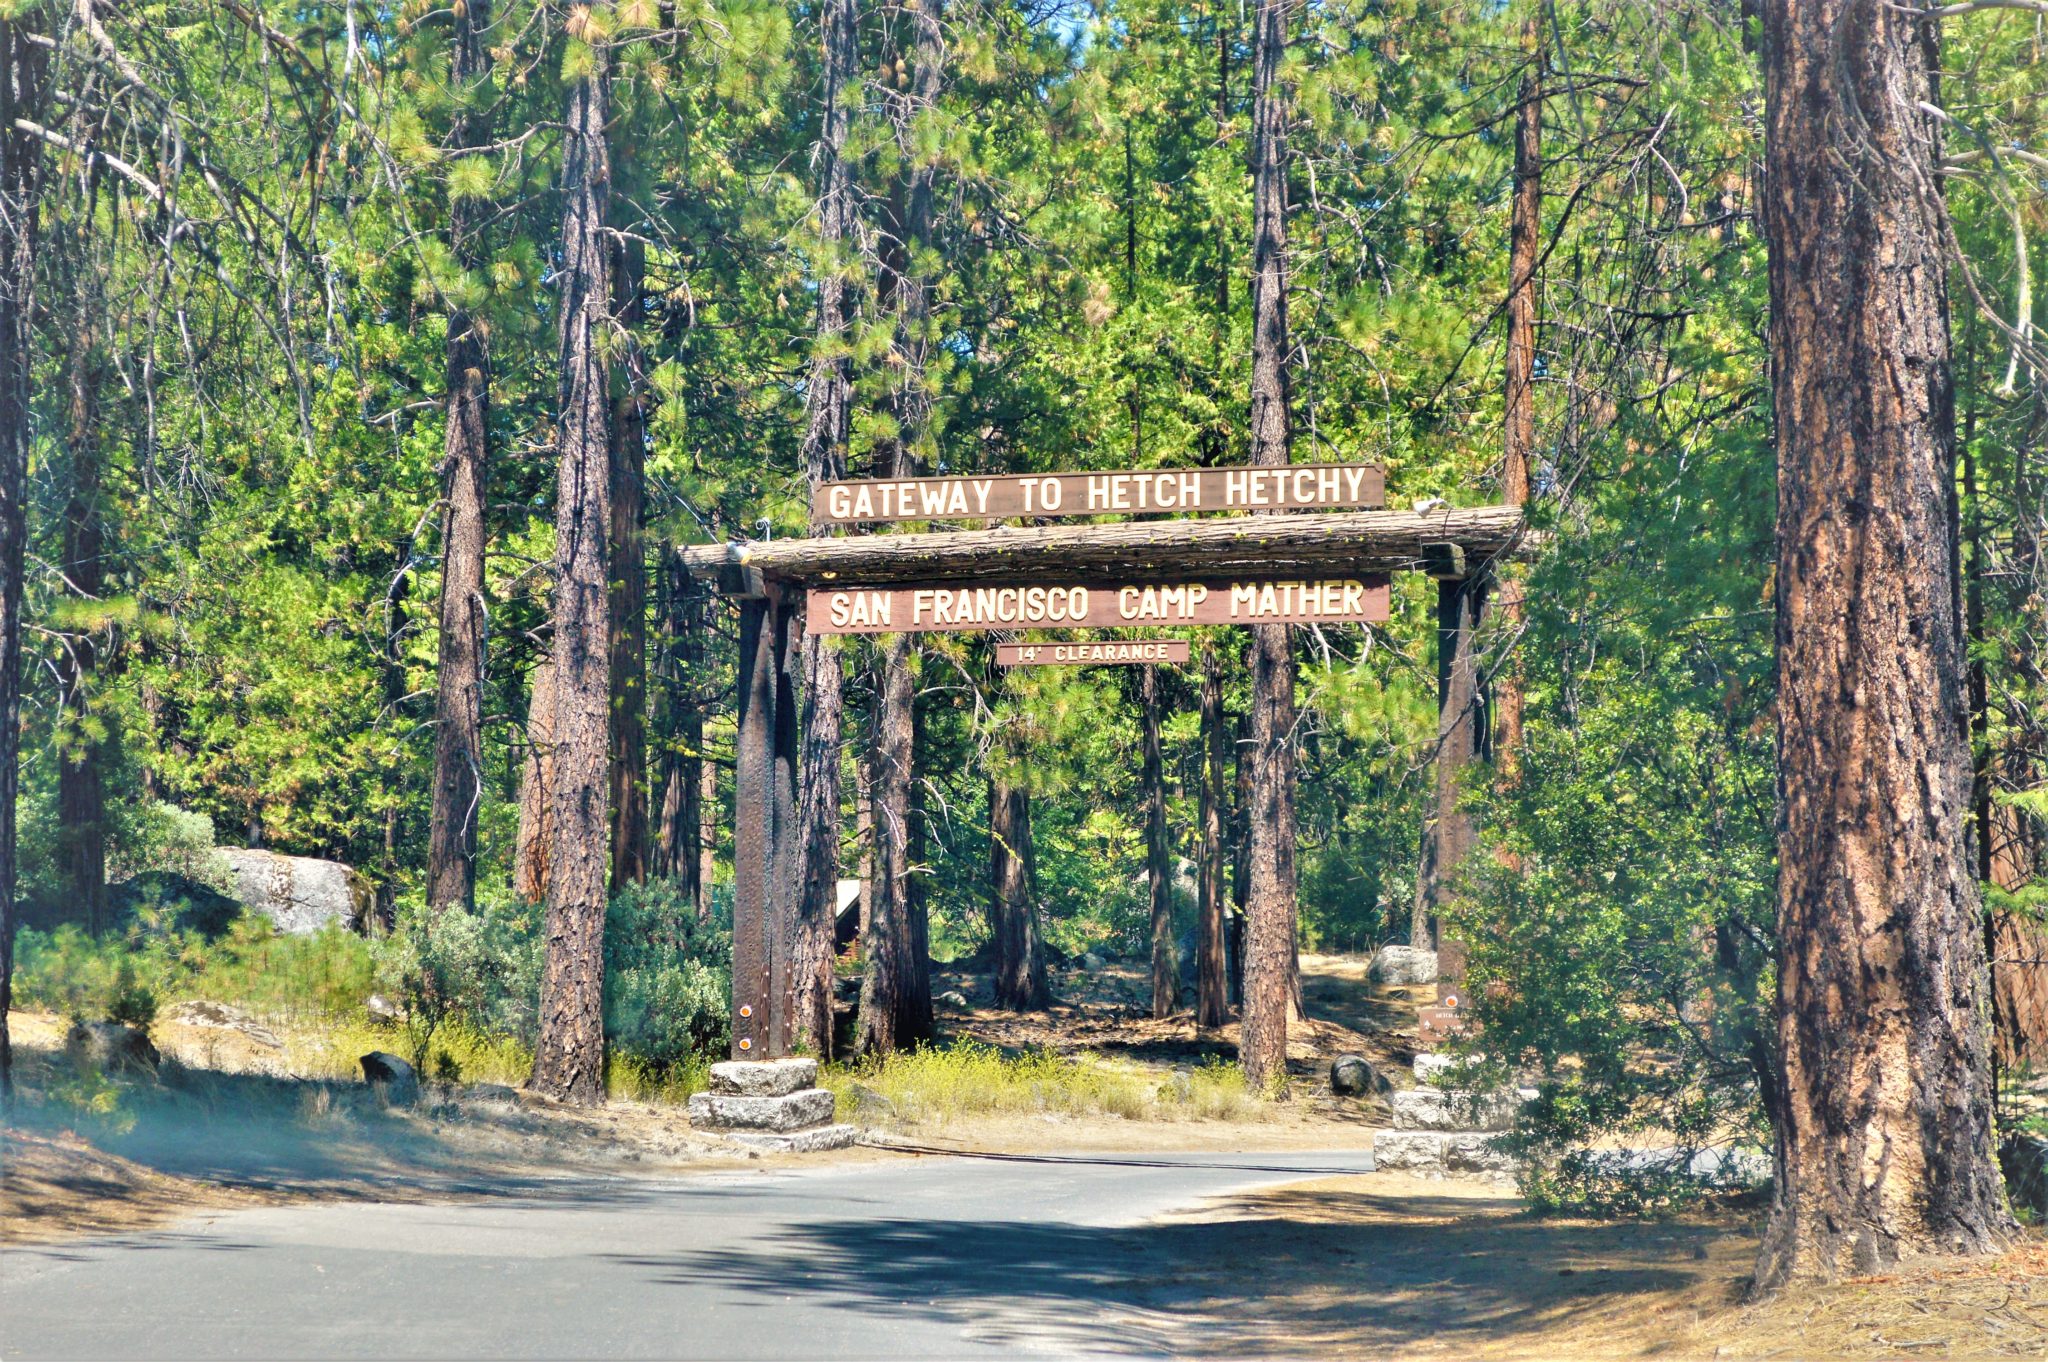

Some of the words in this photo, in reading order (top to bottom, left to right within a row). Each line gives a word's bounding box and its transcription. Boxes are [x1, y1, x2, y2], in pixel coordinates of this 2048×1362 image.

[828, 480, 994, 518] GATEWAY
[1019, 477, 1063, 511] TO
[1087, 473, 1202, 509] HETCH
[1225, 467, 1366, 506] HETCHY
[830, 590, 891, 627] SAN
[913, 585, 1089, 623] FRANCISCO
[1119, 585, 1208, 619] CAMP
[1231, 580, 1364, 616] MATHER
[1055, 644, 1169, 660] CLEARANCE
